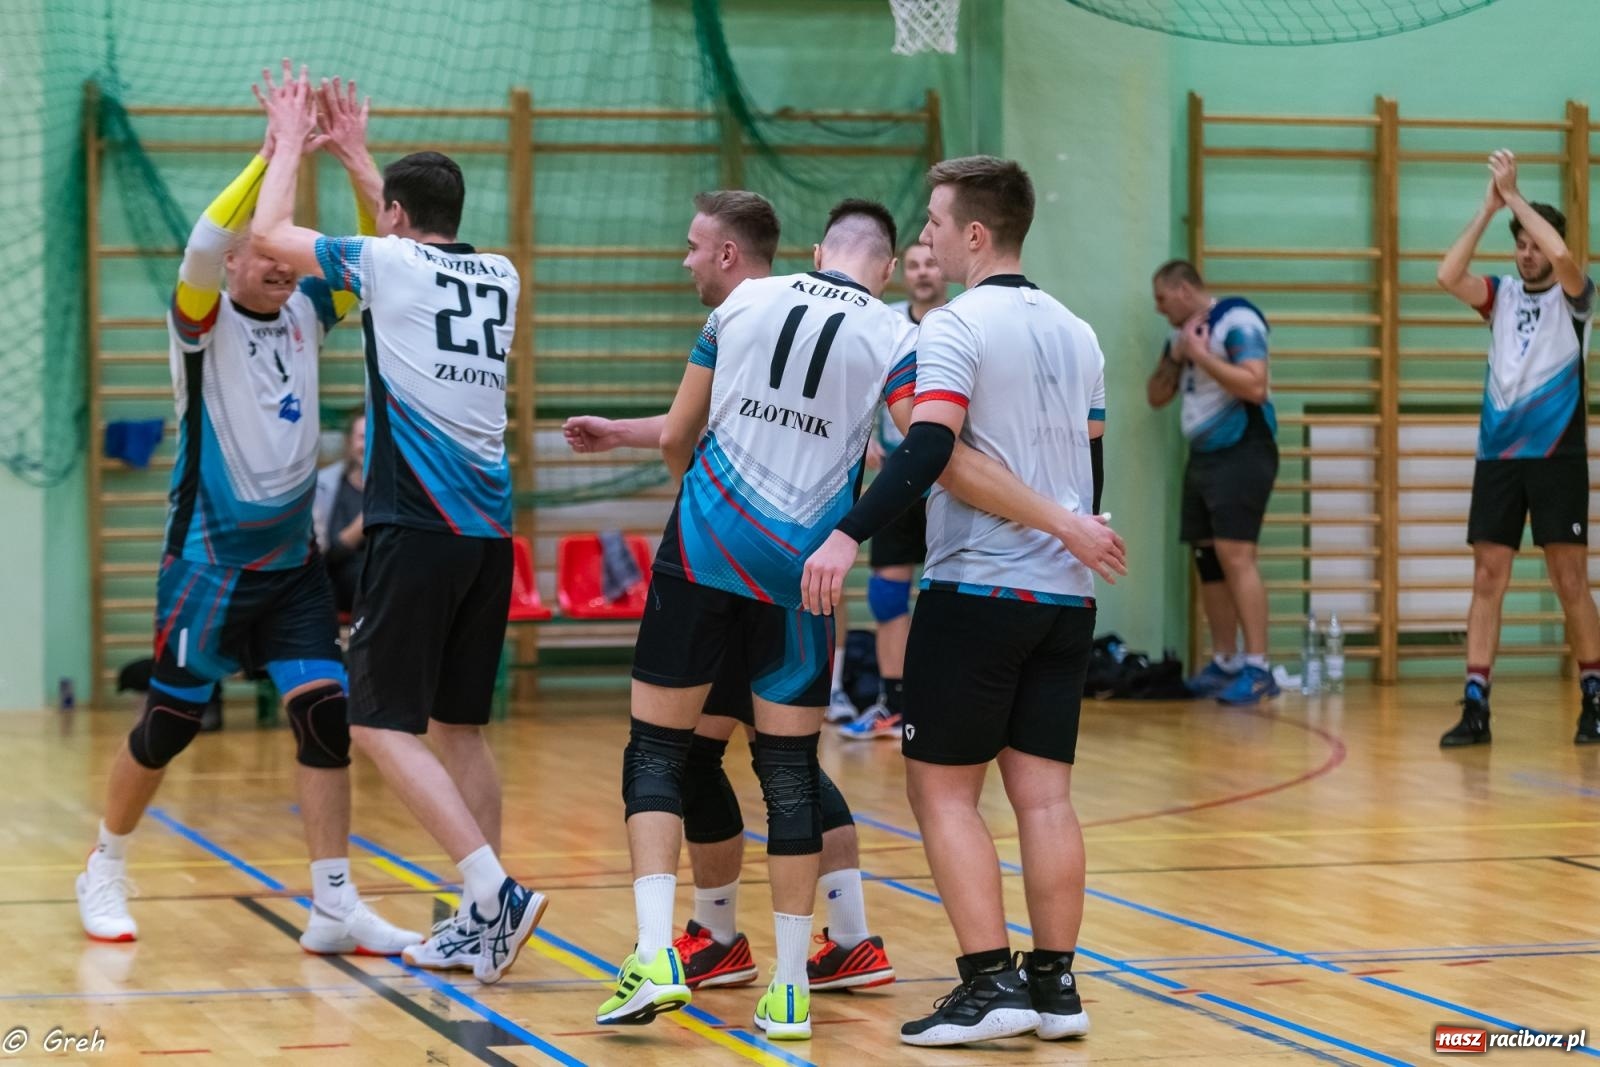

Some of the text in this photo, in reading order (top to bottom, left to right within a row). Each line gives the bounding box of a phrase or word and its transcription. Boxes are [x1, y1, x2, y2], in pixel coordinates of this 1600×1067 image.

[435, 272, 508, 362] 22
[791, 281, 869, 306] KUBUS
[769, 305, 845, 398] 11
[740, 398, 832, 438] ZŁOTNIK
